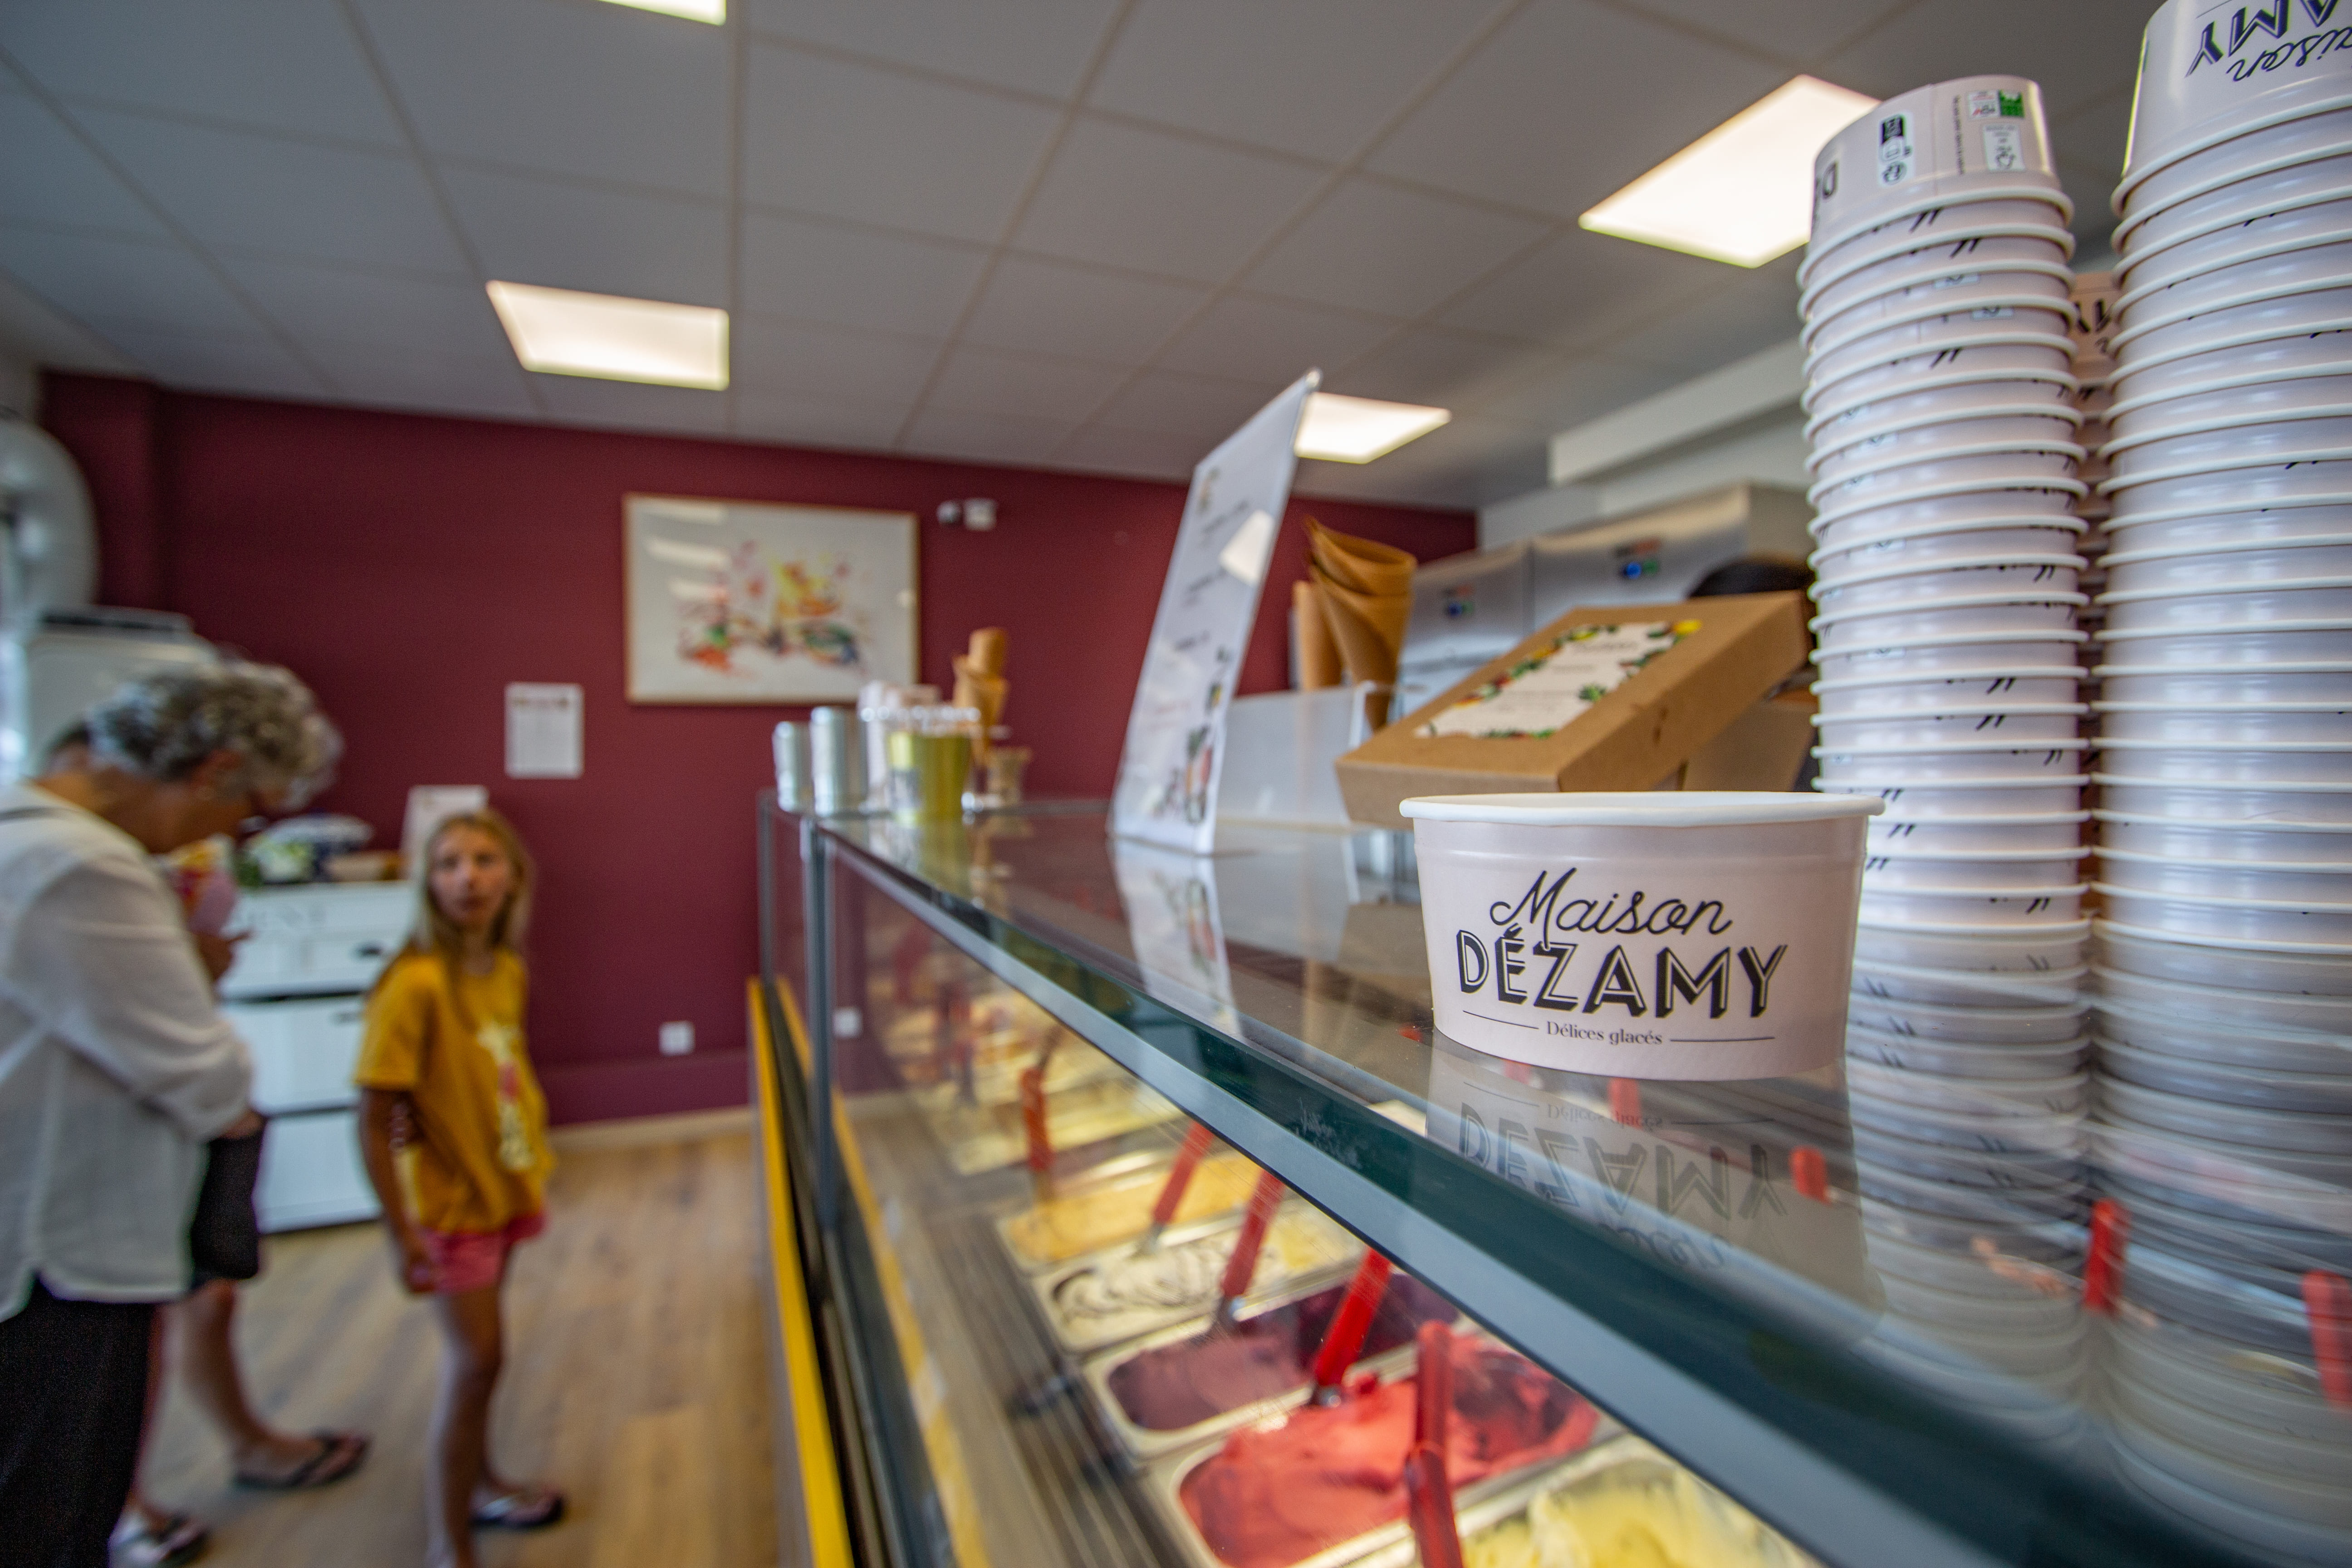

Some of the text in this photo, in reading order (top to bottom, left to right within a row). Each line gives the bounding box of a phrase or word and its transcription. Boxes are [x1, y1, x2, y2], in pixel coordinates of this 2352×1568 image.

[1490, 867, 1733, 951] Maison
[1456, 923, 1788, 1019] DÉZAMY
[1547, 1021, 1663, 1045] Délices glacés
